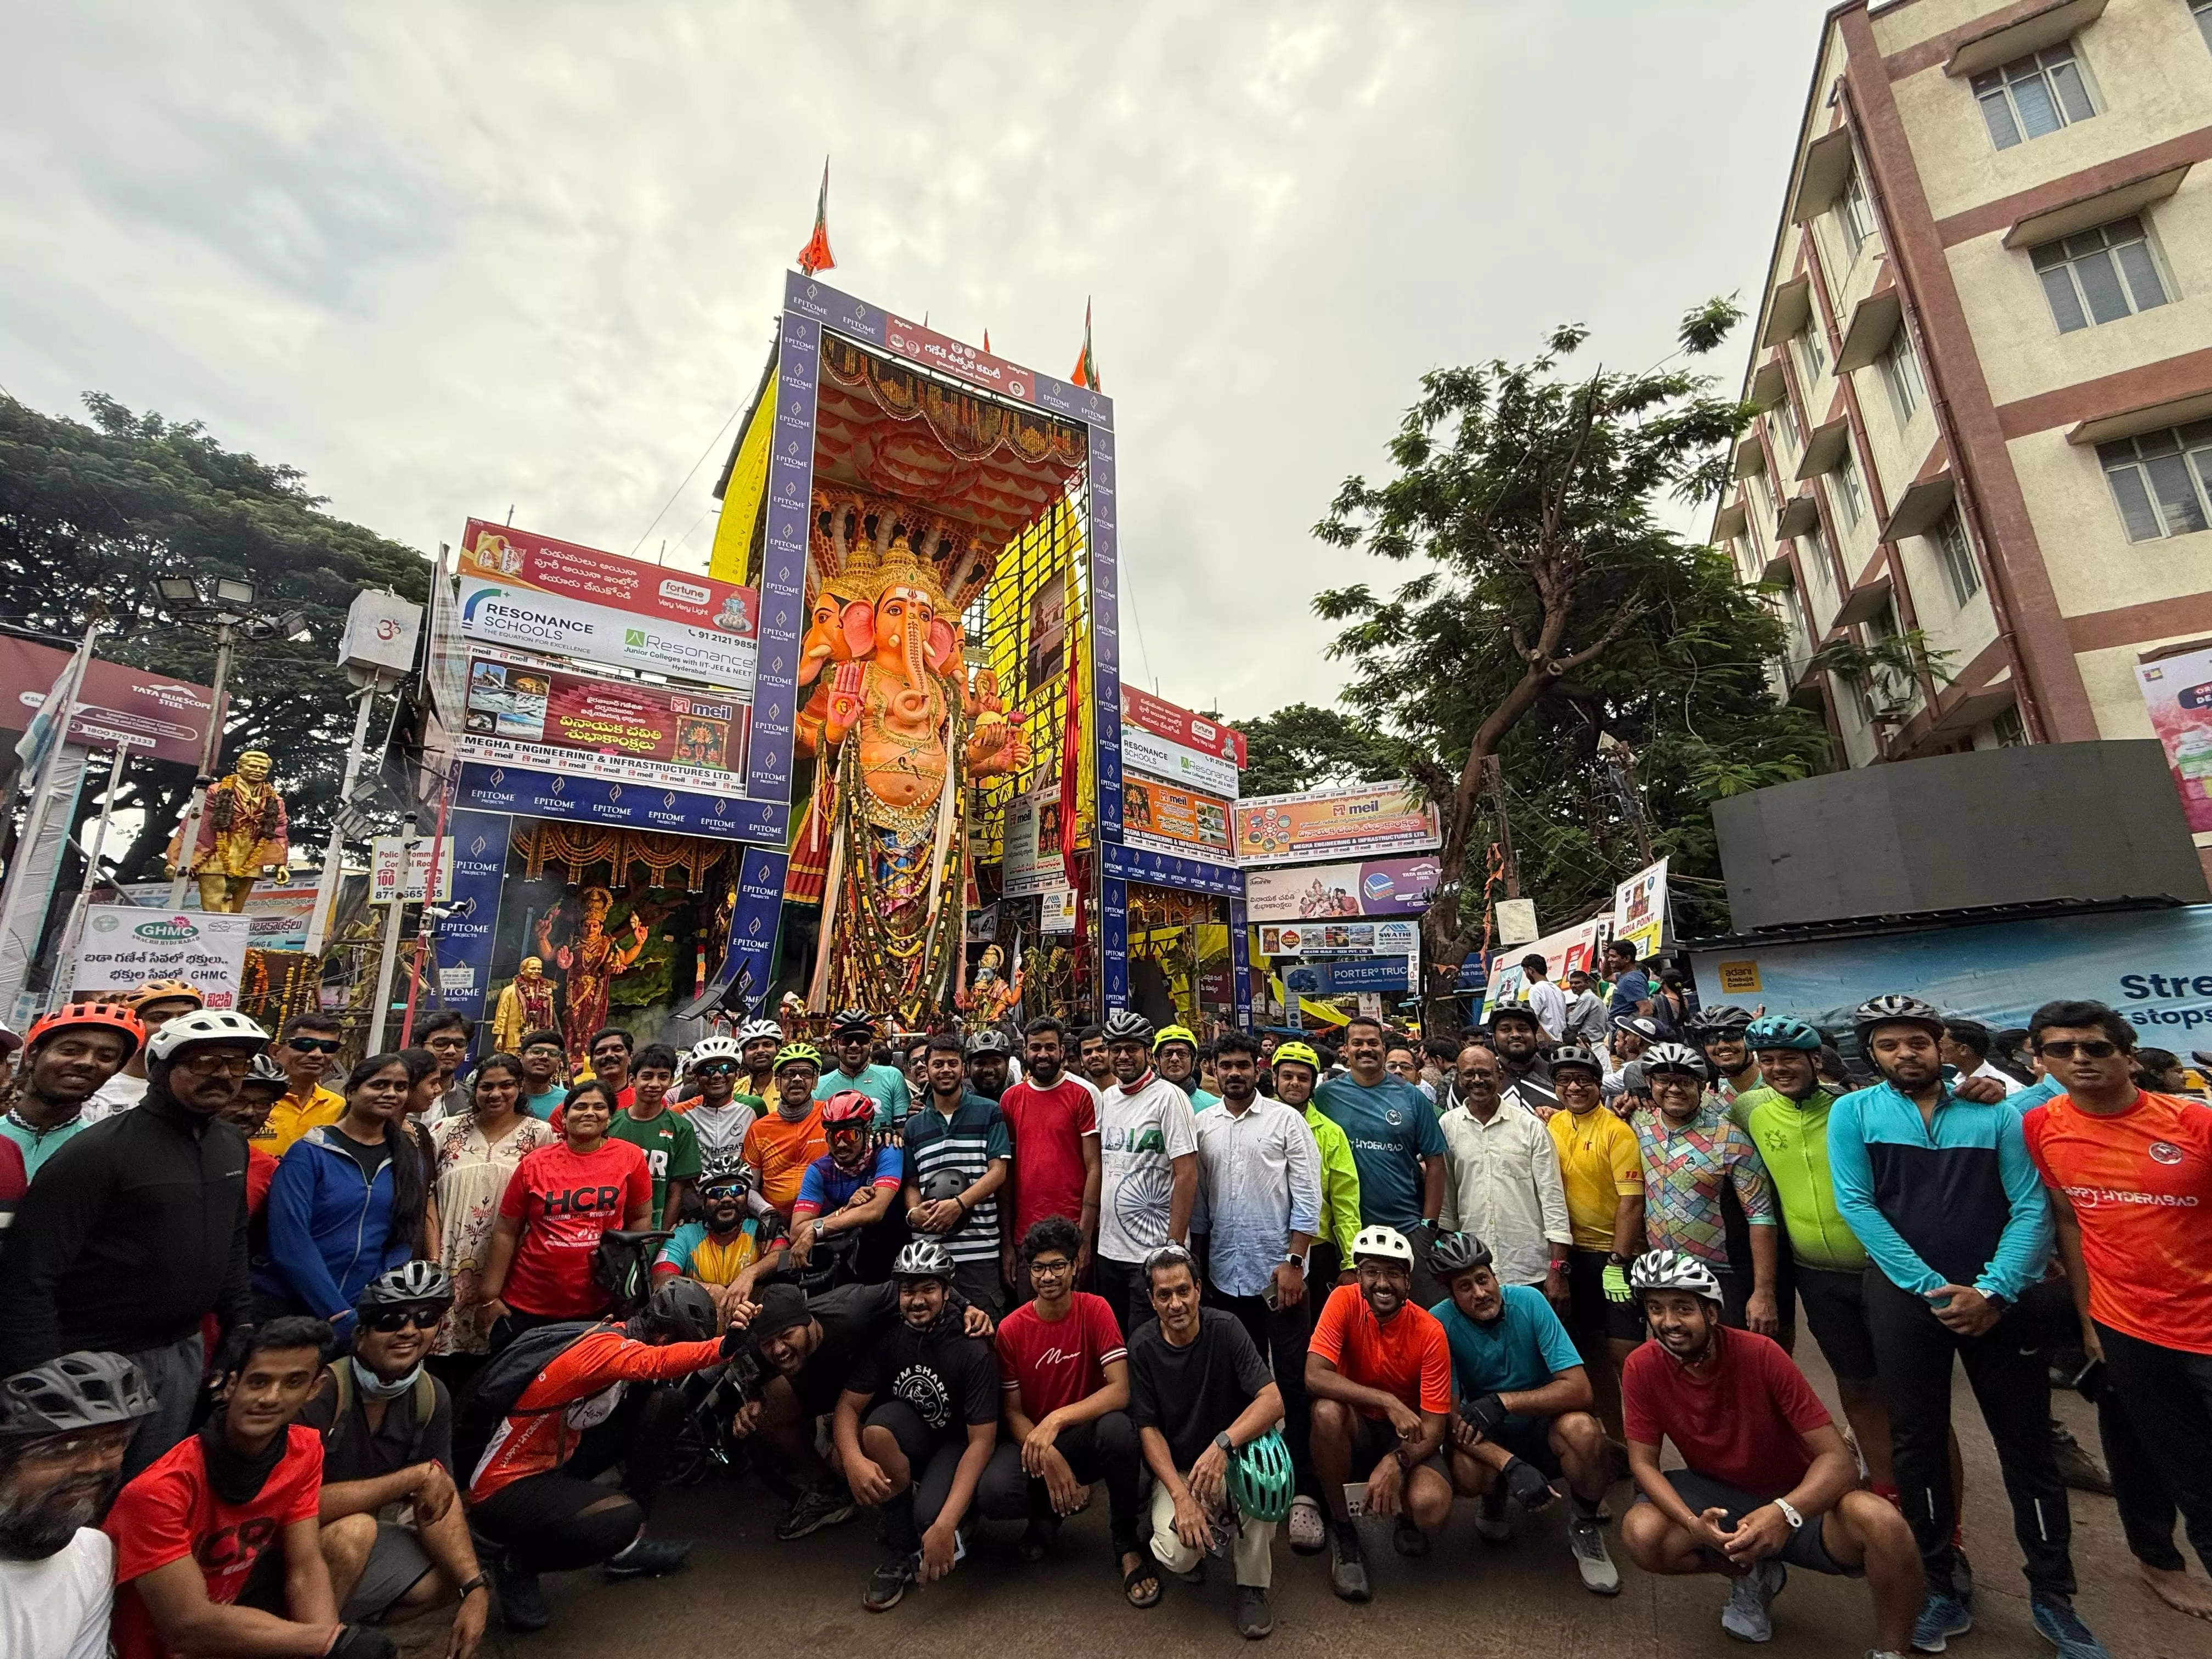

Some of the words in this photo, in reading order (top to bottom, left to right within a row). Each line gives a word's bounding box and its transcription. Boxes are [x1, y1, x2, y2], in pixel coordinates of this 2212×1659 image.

[793, 297, 827, 315] EPITOME
[843, 317, 875, 334] EPITOME
[785, 337, 815, 351] EPITOME
[782, 376, 812, 389] EPITOME
[1043, 394, 1070, 408] EPITOME
[780, 415, 810, 427] EPITOME
[1082, 408, 1106, 421] EPITOME
[776, 455, 808, 467] EPITOME
[774, 496, 805, 509] EPITOME
[534, 558, 559, 569] పూరీ
[562, 565, 601, 579] అయినా
[539, 548, 596, 567] కుడుములు
[600, 563, 637, 576] అయినా
[539, 573, 580, 588] తయారు
[584, 582, 631, 600] చేసుకోండి
[666, 582, 704, 598] fortune
[658, 598, 674, 608] Very
[676, 602, 691, 613] Very
[692, 606, 709, 616] Light
[487, 603, 594, 634] RESONANCE
[484, 617, 562, 640] SCHOOLS
[499, 631, 533, 642] EQUATION
[550, 642, 591, 653] EXCELLENCE
[698, 631, 709, 640] 91
[712, 635, 731, 645] 2121
[735, 639, 757, 650] 9858
[647, 635, 754, 668] Resonance
[624, 647, 648, 656] Junior
[650, 652, 681, 663] Colleges
[699, 662, 724, 672] IIT-JEE
[673, 664, 707, 675] Hyderabad
[132, 685, 159, 696] TATA
[158, 698, 184, 709] STEEL
[692, 704, 732, 720] meil
[560, 715, 624, 734] వినాయక
[627, 726, 662, 740] చవితి
[1194, 723, 1213, 736] fortune
[87, 726, 110, 736] 1800
[112, 731, 129, 740] 270
[130, 736, 153, 745] 8333
[565, 729, 655, 753] శుభాకాంక్షలు
[1191, 735, 1200, 743] Very
[1124, 740, 1168, 760] RESONANCE
[1124, 749, 1157, 765] SCHOOLS
[465, 736, 511, 749] MEGHA
[515, 744, 594, 761] ENGINEERING
[610, 757, 710, 777] INFRASTRUCTURES
[713, 772, 732, 781] LTD.
[1189, 760, 1235, 783] Resonance
[1192, 771, 1205, 780] Colleges
[471, 789, 515, 802] EPITOME
[1170, 794, 1187, 806] meil
[534, 797, 575, 809] EPITOME
[593, 804, 632, 815] EPITOME
[1349, 800, 1379, 815] meil
[648, 811, 685, 822] EPITOME
[701, 818, 736, 828] EPITOME
[1017, 810, 1031, 823] meil
[749, 824, 782, 834] EPITOME
[1298, 827, 1335, 838] వినాయక
[1336, 825, 1359, 834] చవితి
[1361, 819, 1419, 831] శుభాకాంక్షలు
[1141, 831, 1173, 843] ENGINEERING
[1179, 839, 1220, 854] INFRASTRUCTURES
[1314, 839, 1351, 848] ENGINEERING
[1358, 833, 1413, 843] INFRASTRUCTURES
[377, 875, 394, 885] 100
[743, 884, 778, 896] EPITOME
[1278, 893, 1294, 901] చవితి
[142, 926, 194, 936] GHMC
[441, 923, 489, 933] EPITOME
[1619, 923, 1634, 936] MEDIA
[1637, 912, 1655, 928] POINT
[733, 938, 769, 949] EPITOME
[84, 953, 112, 962] బడా
[115, 952, 148, 963] గణేశ్
[149, 952, 184, 963] సేవలో
[109, 970, 145, 982] భక్తుల
[148, 968, 183, 979] సేవలో
[191, 970, 228, 980] GHMC
[1725, 967, 1752, 977] adani
[431, 988, 479, 996] EITOME
[2120, 974, 2212, 999] Stre
[1104, 1126, 1165, 1154] DIA
[1356, 1138, 1403, 1151] HYDERABAD
[544, 1187, 619, 1215] HCR
[2102, 1190, 2199, 1206] HYDERABAD
[893, 1367, 911, 1395] GYM
[915, 1364, 949, 1403] SHARK
